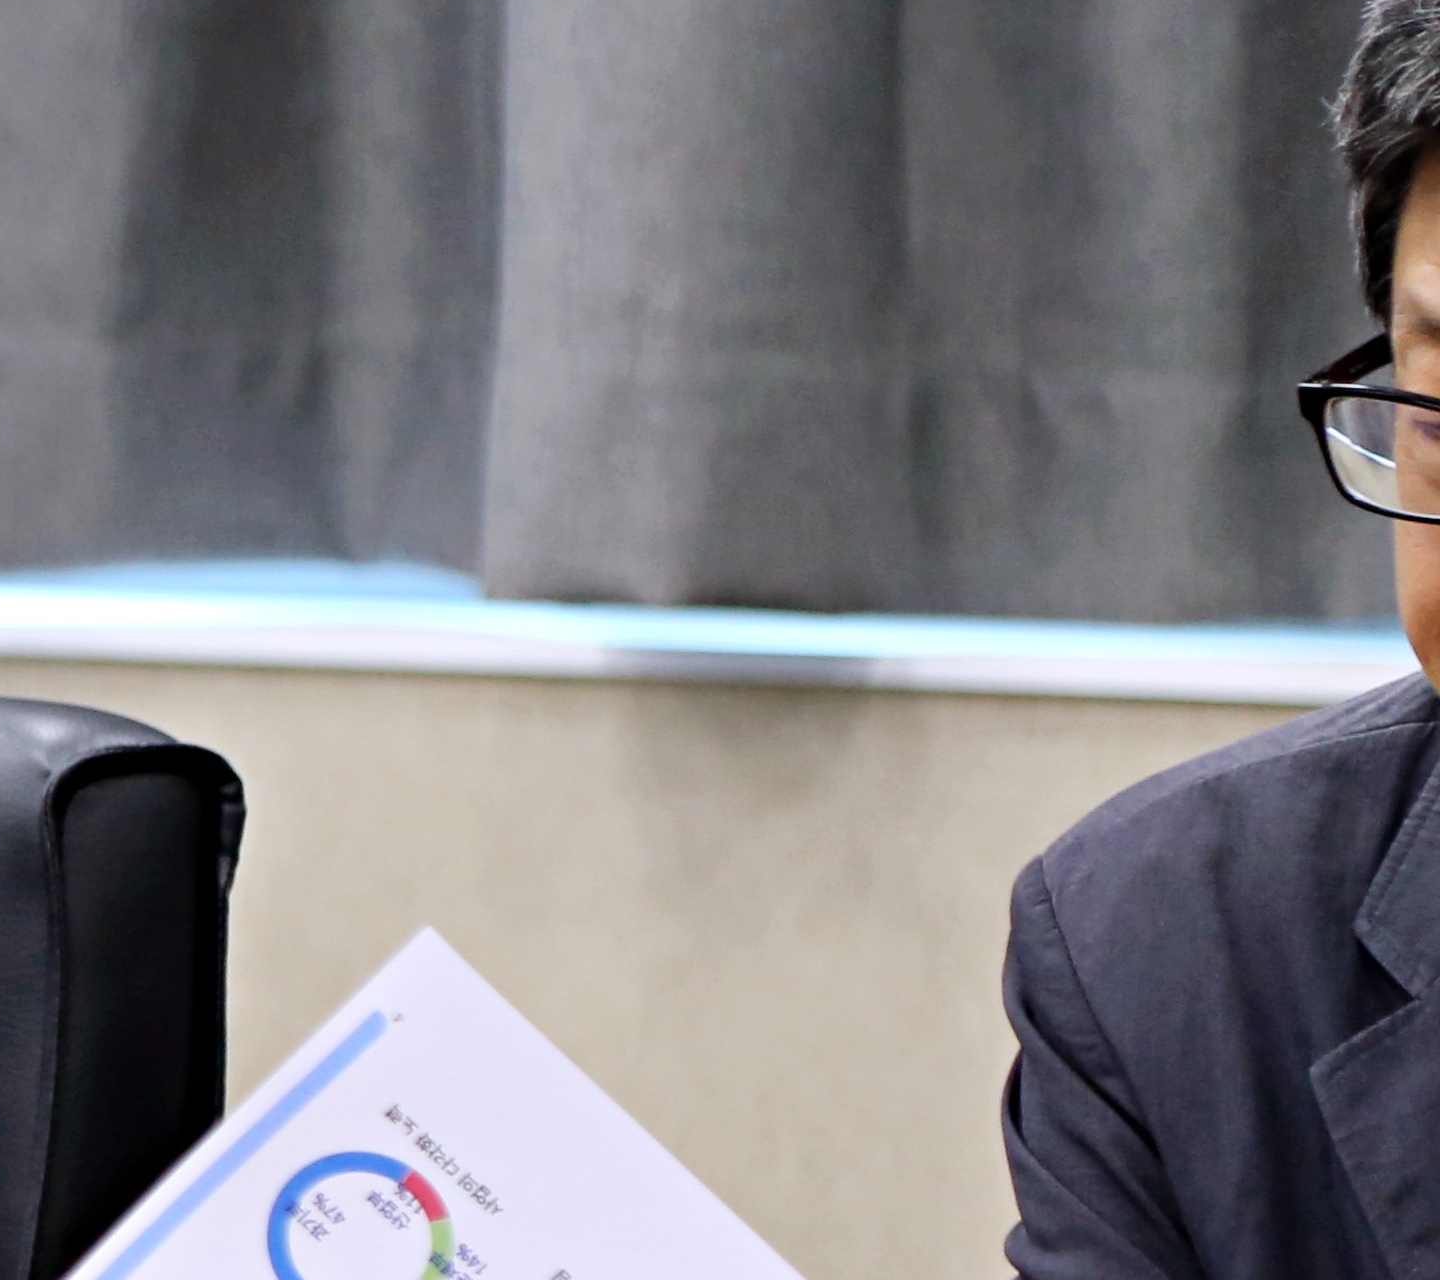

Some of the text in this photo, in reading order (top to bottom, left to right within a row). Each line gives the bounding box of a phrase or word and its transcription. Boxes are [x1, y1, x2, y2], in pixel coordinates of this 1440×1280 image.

[414, 1131, 462, 1176] 다각화
[312, 1192, 346, 1225] 47%
[457, 1172, 504, 1216] 사업의
